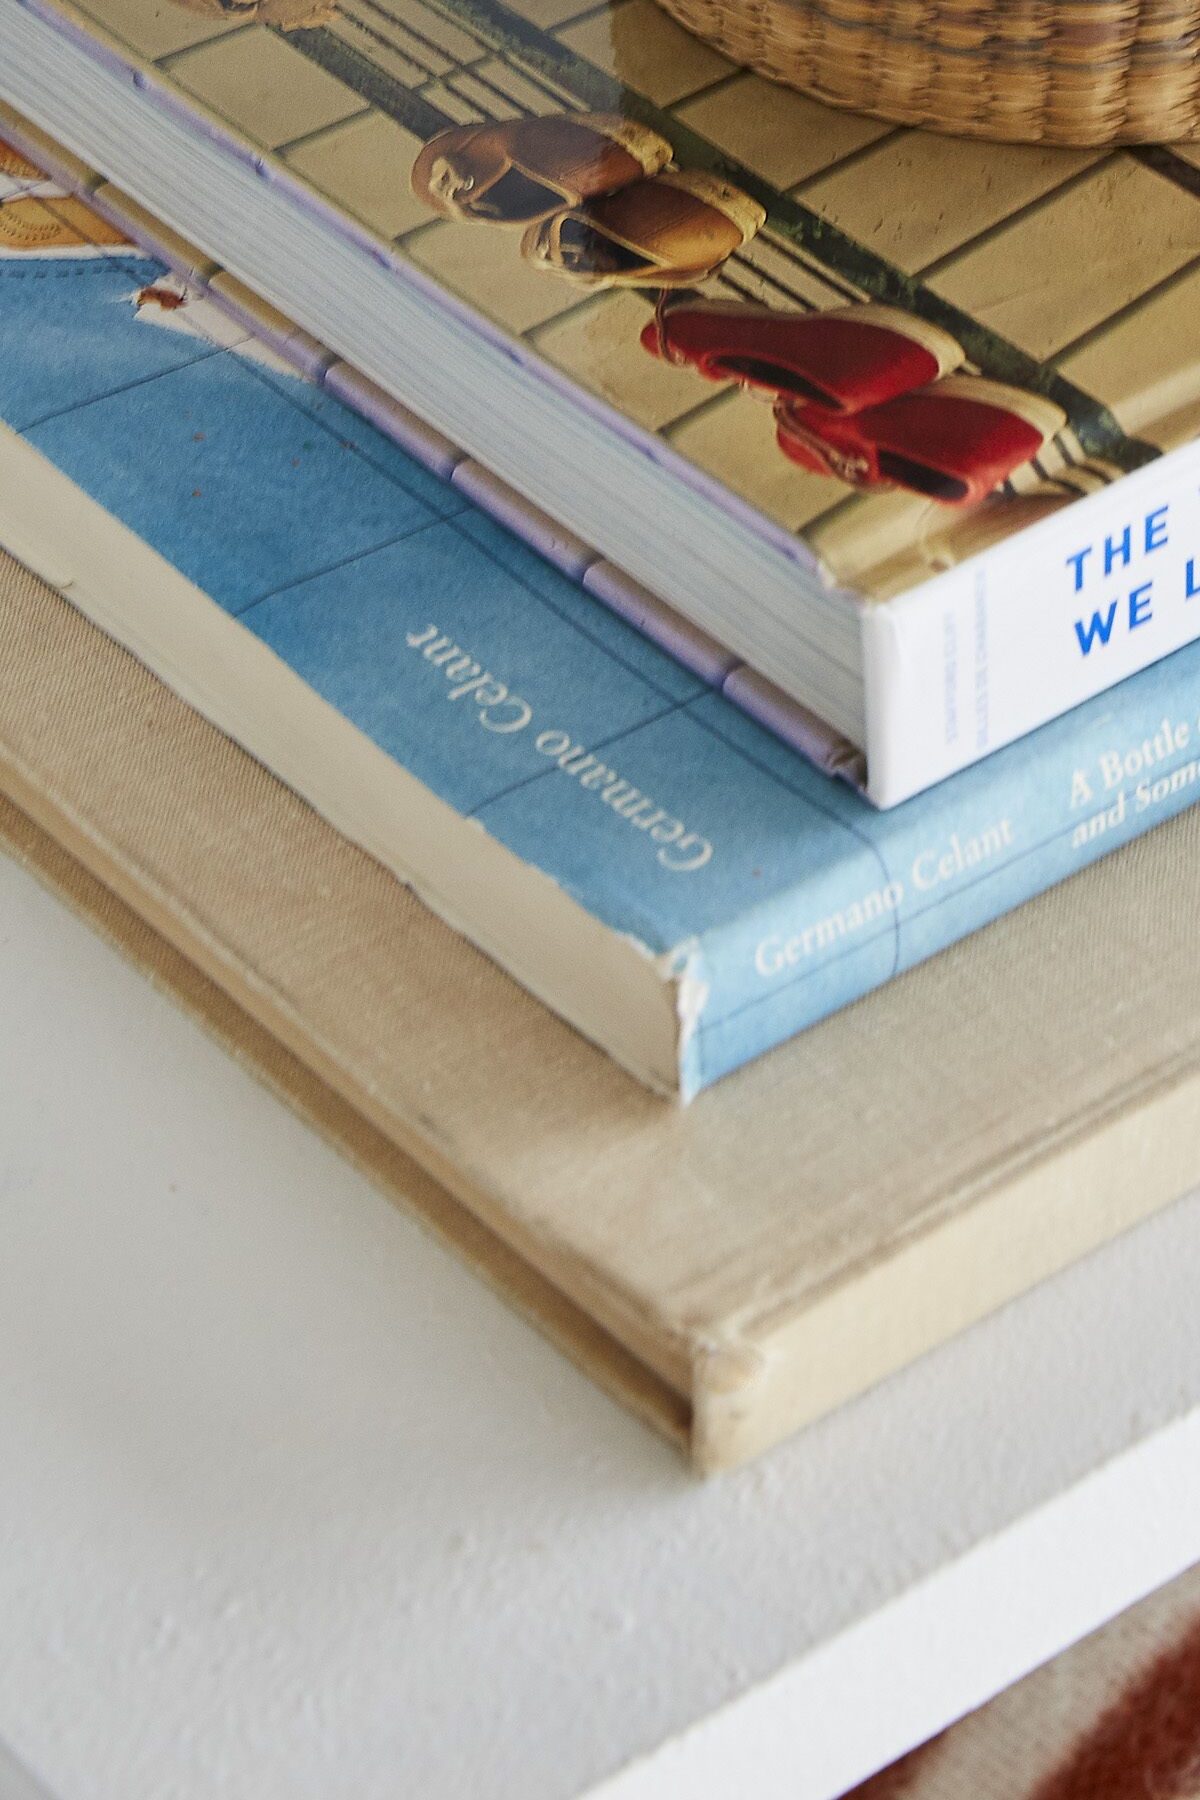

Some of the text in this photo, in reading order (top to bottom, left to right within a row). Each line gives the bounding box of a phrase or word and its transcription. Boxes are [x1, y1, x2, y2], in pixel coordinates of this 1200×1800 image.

[1067, 506, 1171, 593] THE
[1074, 582, 1154, 659] WE
[405, 623, 713, 871] Germano Celant
[1070, 767, 1093, 809] A
[1099, 717, 1190, 790] Bottle
[1072, 790, 1126, 849] and
[754, 817, 1016, 977] Germano Celant
